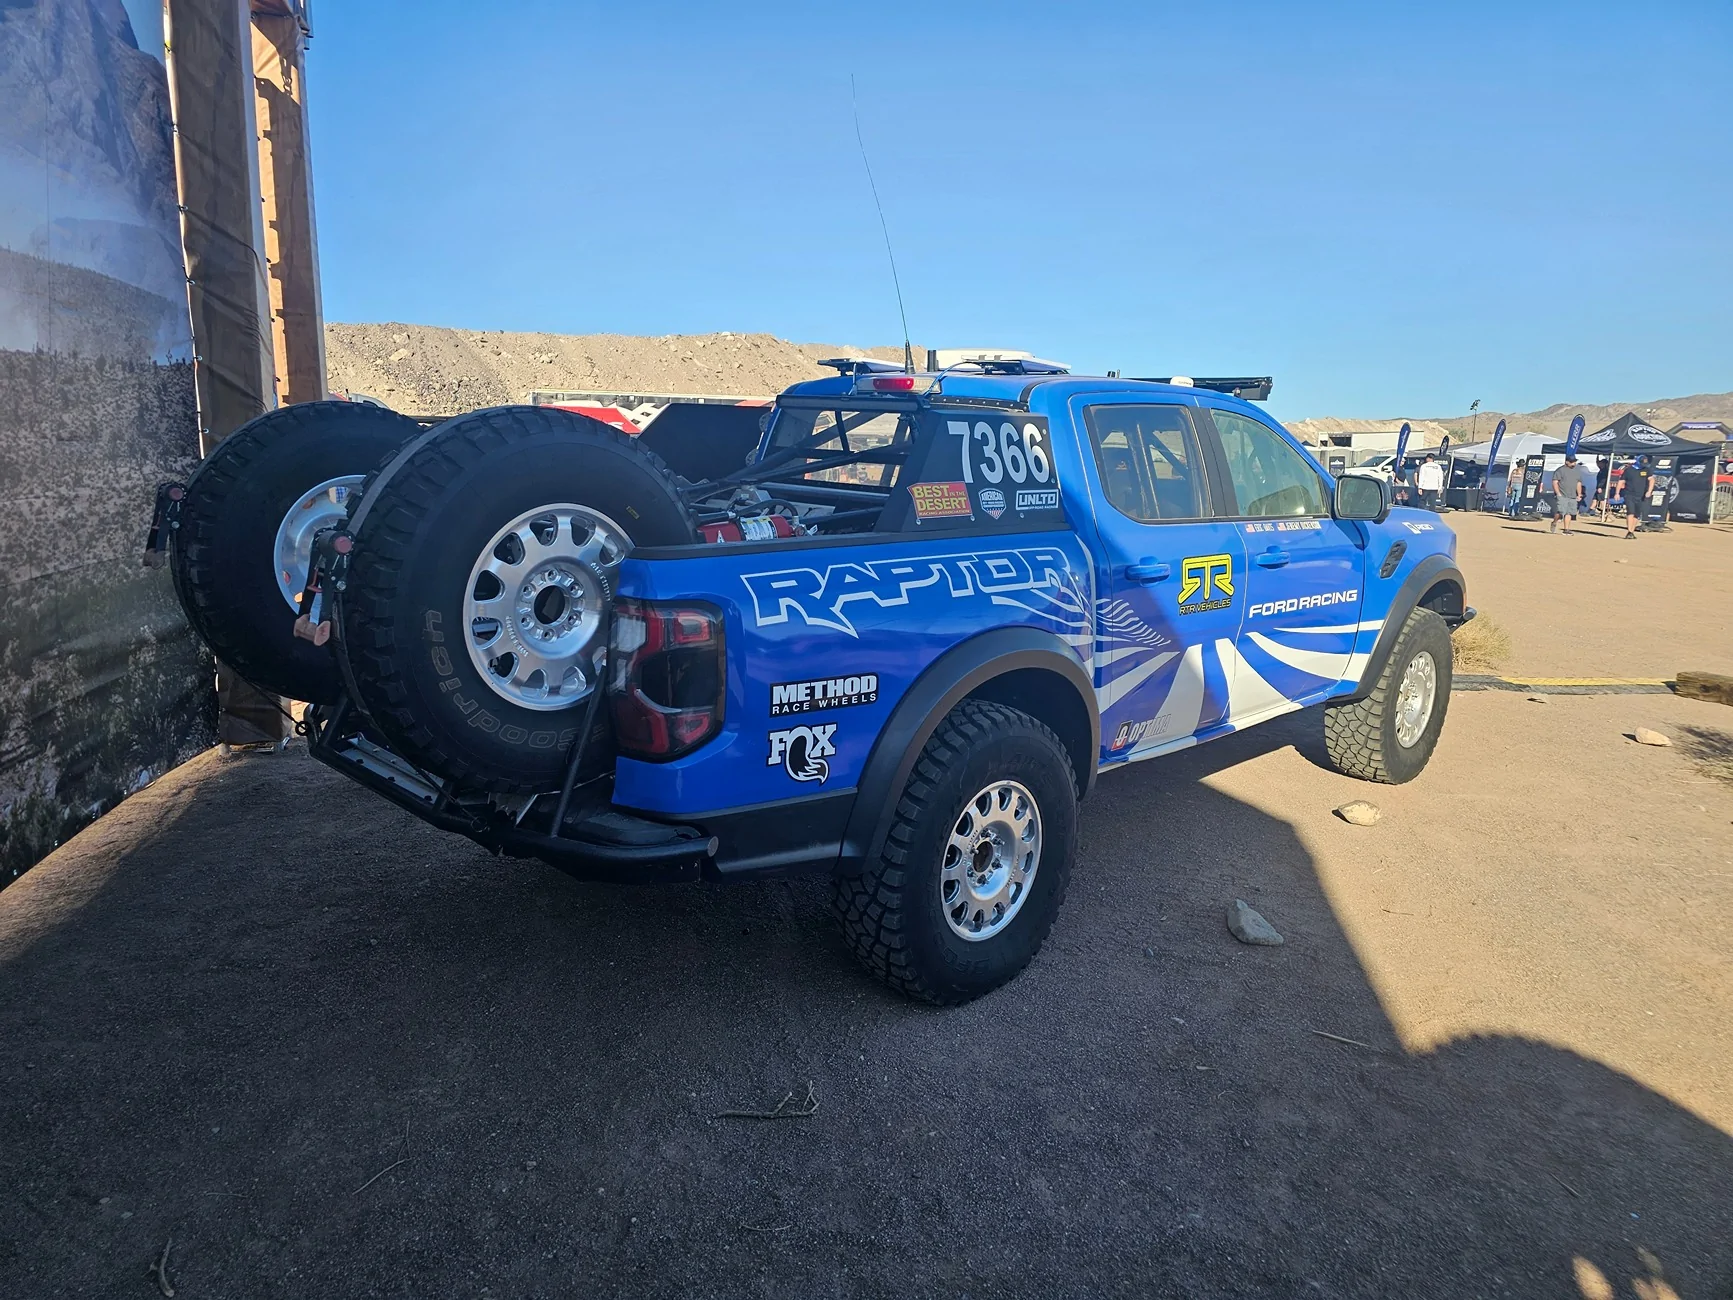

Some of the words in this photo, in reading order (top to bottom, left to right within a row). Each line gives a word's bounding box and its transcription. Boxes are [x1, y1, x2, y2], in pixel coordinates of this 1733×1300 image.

[947, 421, 1050, 484] 7366
[912, 484, 949, 498] BEST
[916, 497, 967, 511] DESERT
[740, 547, 1070, 639] RAPTOR
[1179, 603, 1197, 616] RTR
[1197, 598, 1231, 612] VEHICLES
[1249, 602, 1298, 618] FORD
[1299, 590, 1358, 610] RACING
[772, 675, 877, 704] METHOD
[772, 702, 810, 714] RACE
[818, 693, 877, 708] WHEELS
[1128, 714, 1172, 743] OPTIMA
[768, 723, 837, 783] FOX
